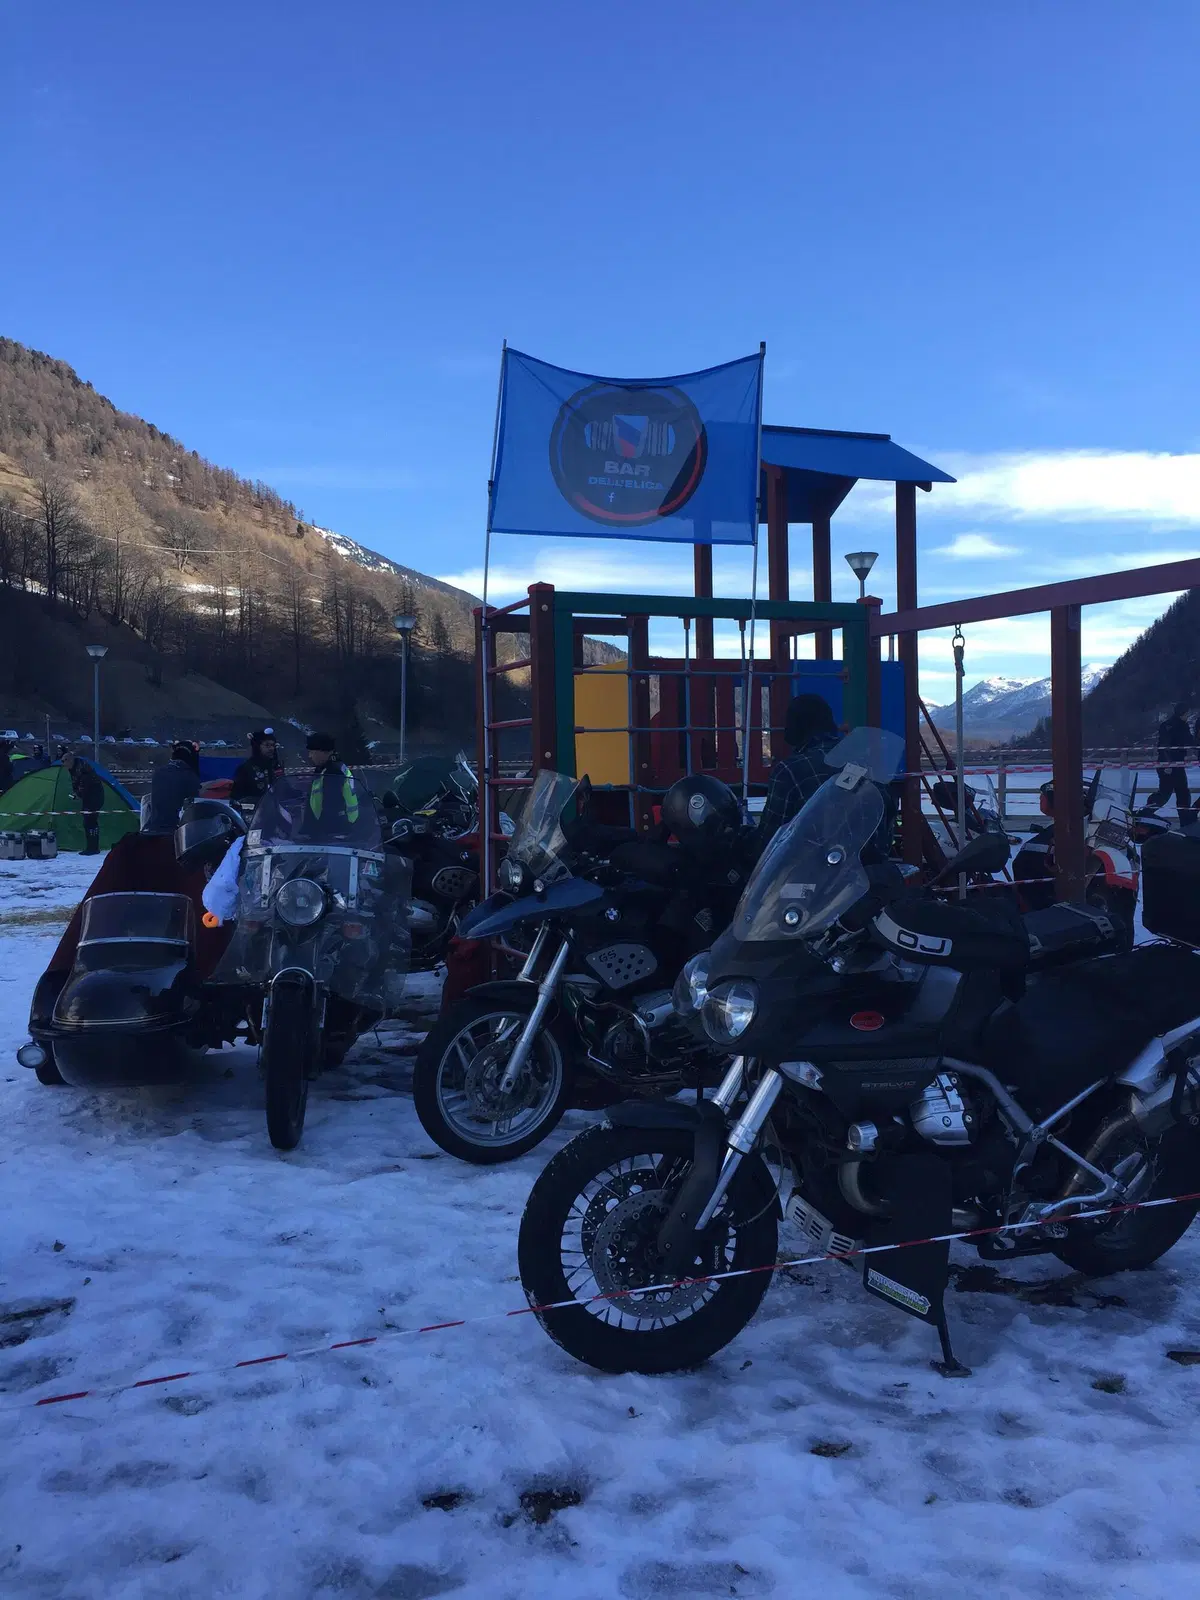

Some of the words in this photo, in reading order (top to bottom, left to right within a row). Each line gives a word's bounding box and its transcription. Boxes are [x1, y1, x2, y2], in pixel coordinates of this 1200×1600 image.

[604, 461, 651, 476] BAR
[588, 476, 663, 489] DELL'ELICA
[598, 949, 616, 962] GS
